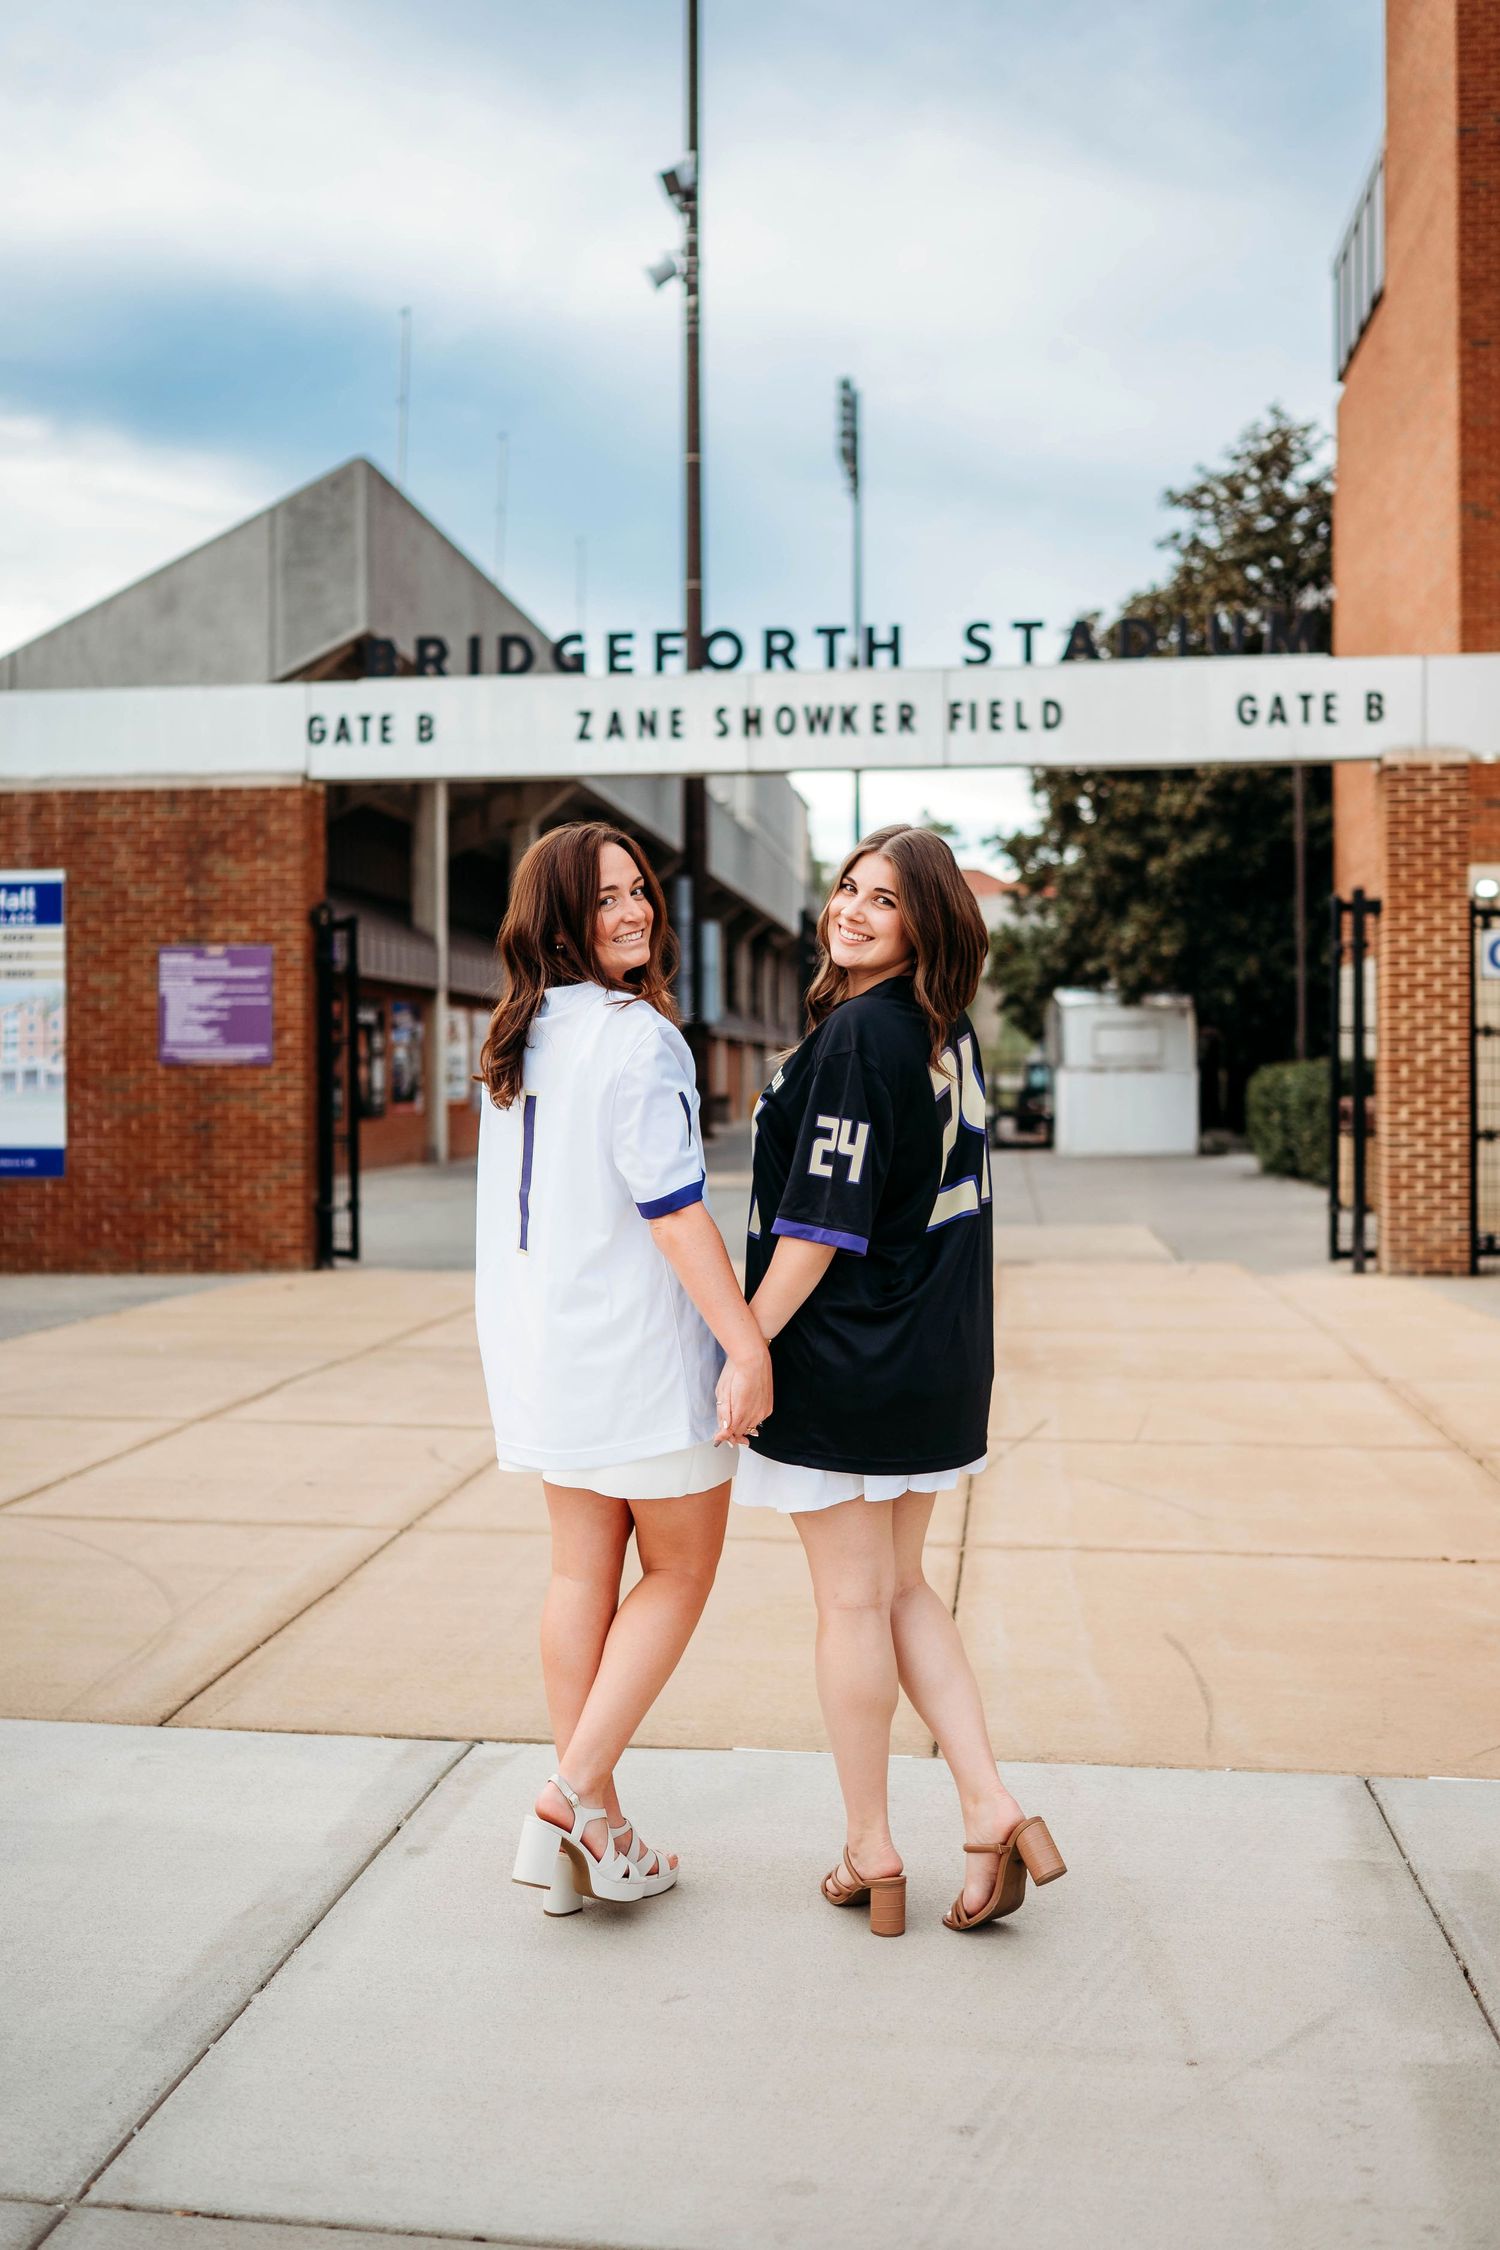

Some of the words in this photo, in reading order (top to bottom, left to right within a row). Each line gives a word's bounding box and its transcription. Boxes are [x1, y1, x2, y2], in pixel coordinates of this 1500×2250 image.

[367, 624, 901, 676] BRIDGEFORTH
[962, 610, 1320, 665] STADIUM
[307, 712, 394, 745] GATE
[416, 713, 436, 744] B
[576, 708, 685, 742] ZANE
[716, 702, 915, 738] SHOWKER
[948, 699, 1063, 733] FIELD
[1236, 693, 1339, 727] GATE
[1365, 691, 1385, 723] B
[807, 1113, 871, 1186] 24
